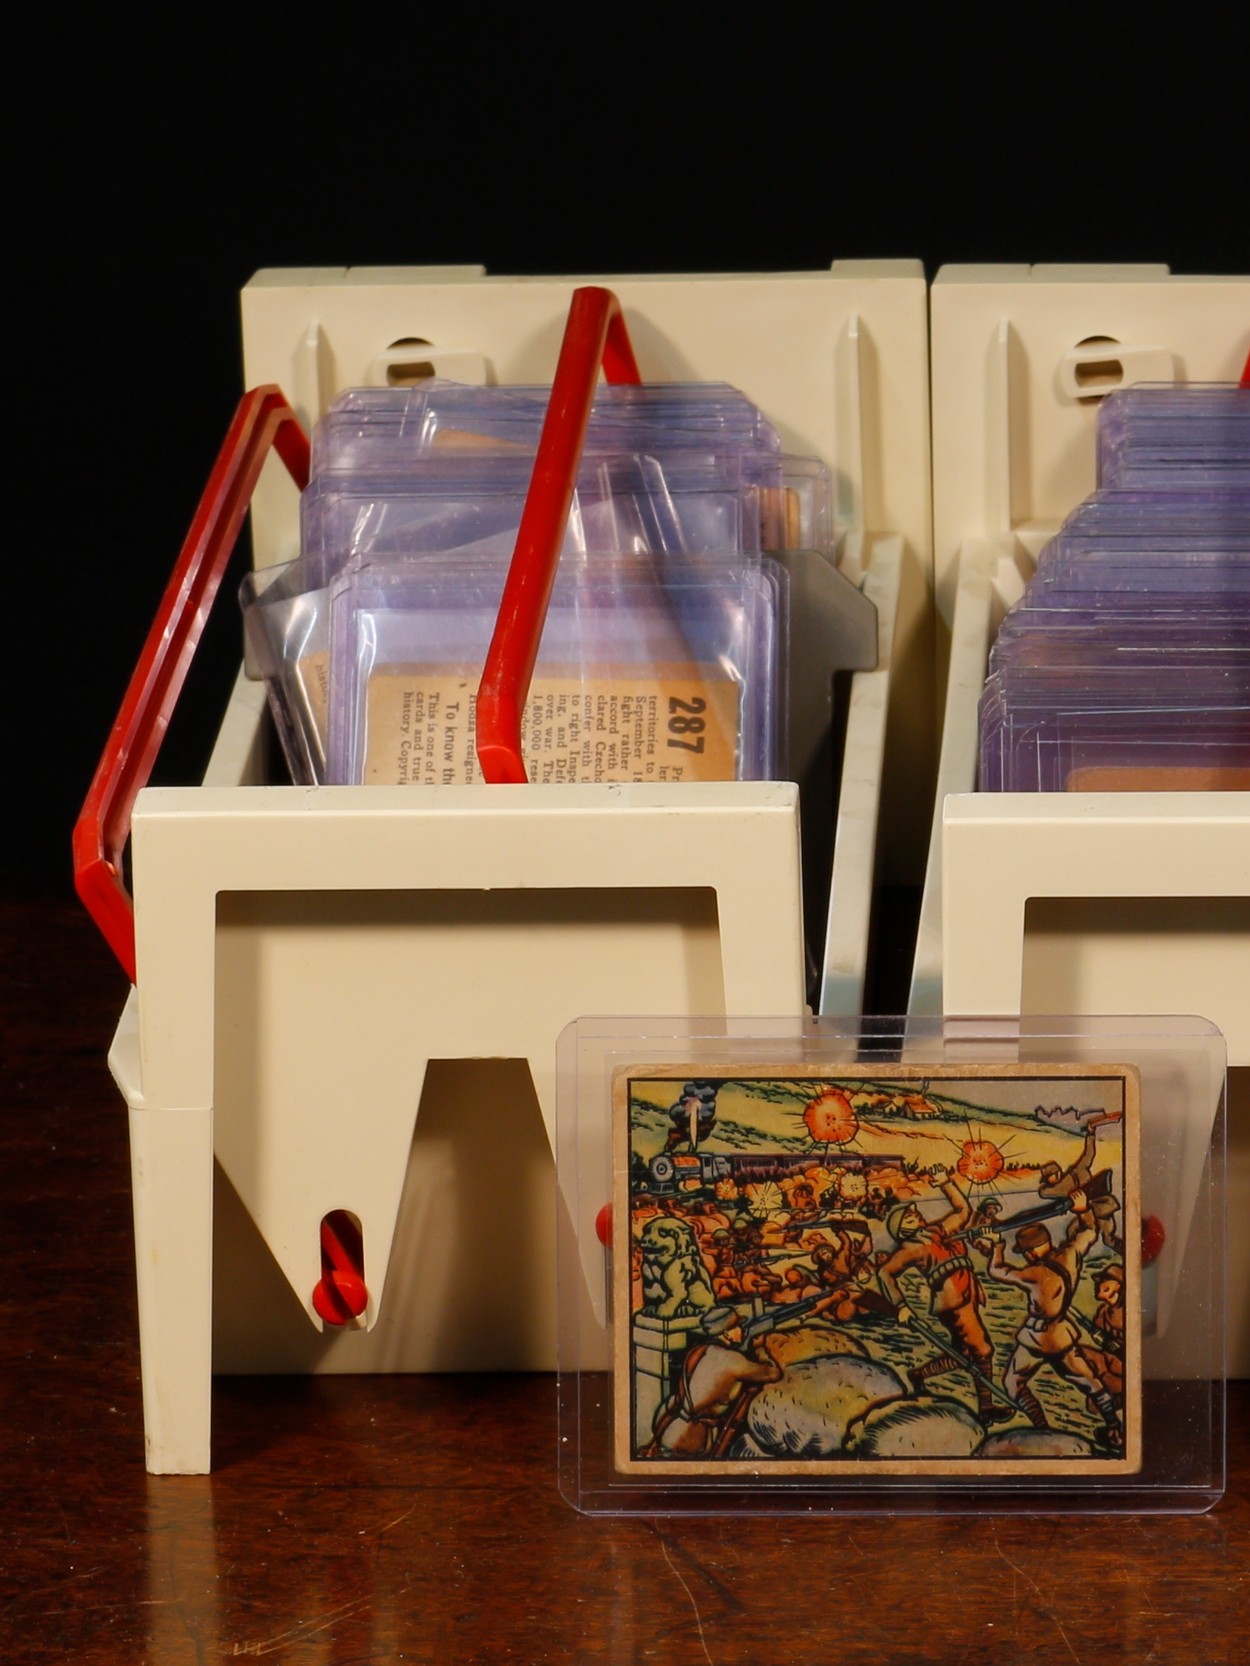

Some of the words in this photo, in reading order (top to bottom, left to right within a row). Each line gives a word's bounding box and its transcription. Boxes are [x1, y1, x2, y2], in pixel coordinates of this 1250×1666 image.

[415, 692, 425, 722] cards
[428, 692, 439, 719] This
[446, 702, 459, 719] To
[572, 695, 580, 706] to
[584, 696, 594, 732] confer
[596, 696, 608, 731] clared
[621, 696, 633, 723] fight
[428, 724, 438, 732] is
[531, 695, 543, 750] 1,800,000
[569, 714, 581, 742] right
[609, 696, 619, 734] accord
[634, 696, 646, 759] September
[647, 696, 658, 755] territories
[668, 696, 706, 754] 287
[414, 729, 424, 750] and
[426, 737, 434, 757] one
[444, 727, 457, 762] know
[544, 728, 552, 753] war.
[557, 727, 567, 748] and
[582, 741, 592, 767] with
[608, 744, 618, 769] with
[621, 735, 632, 770] rather
[412, 757, 421, 781] true
[426, 761, 435, 773] of
[647, 763, 655, 773] to
